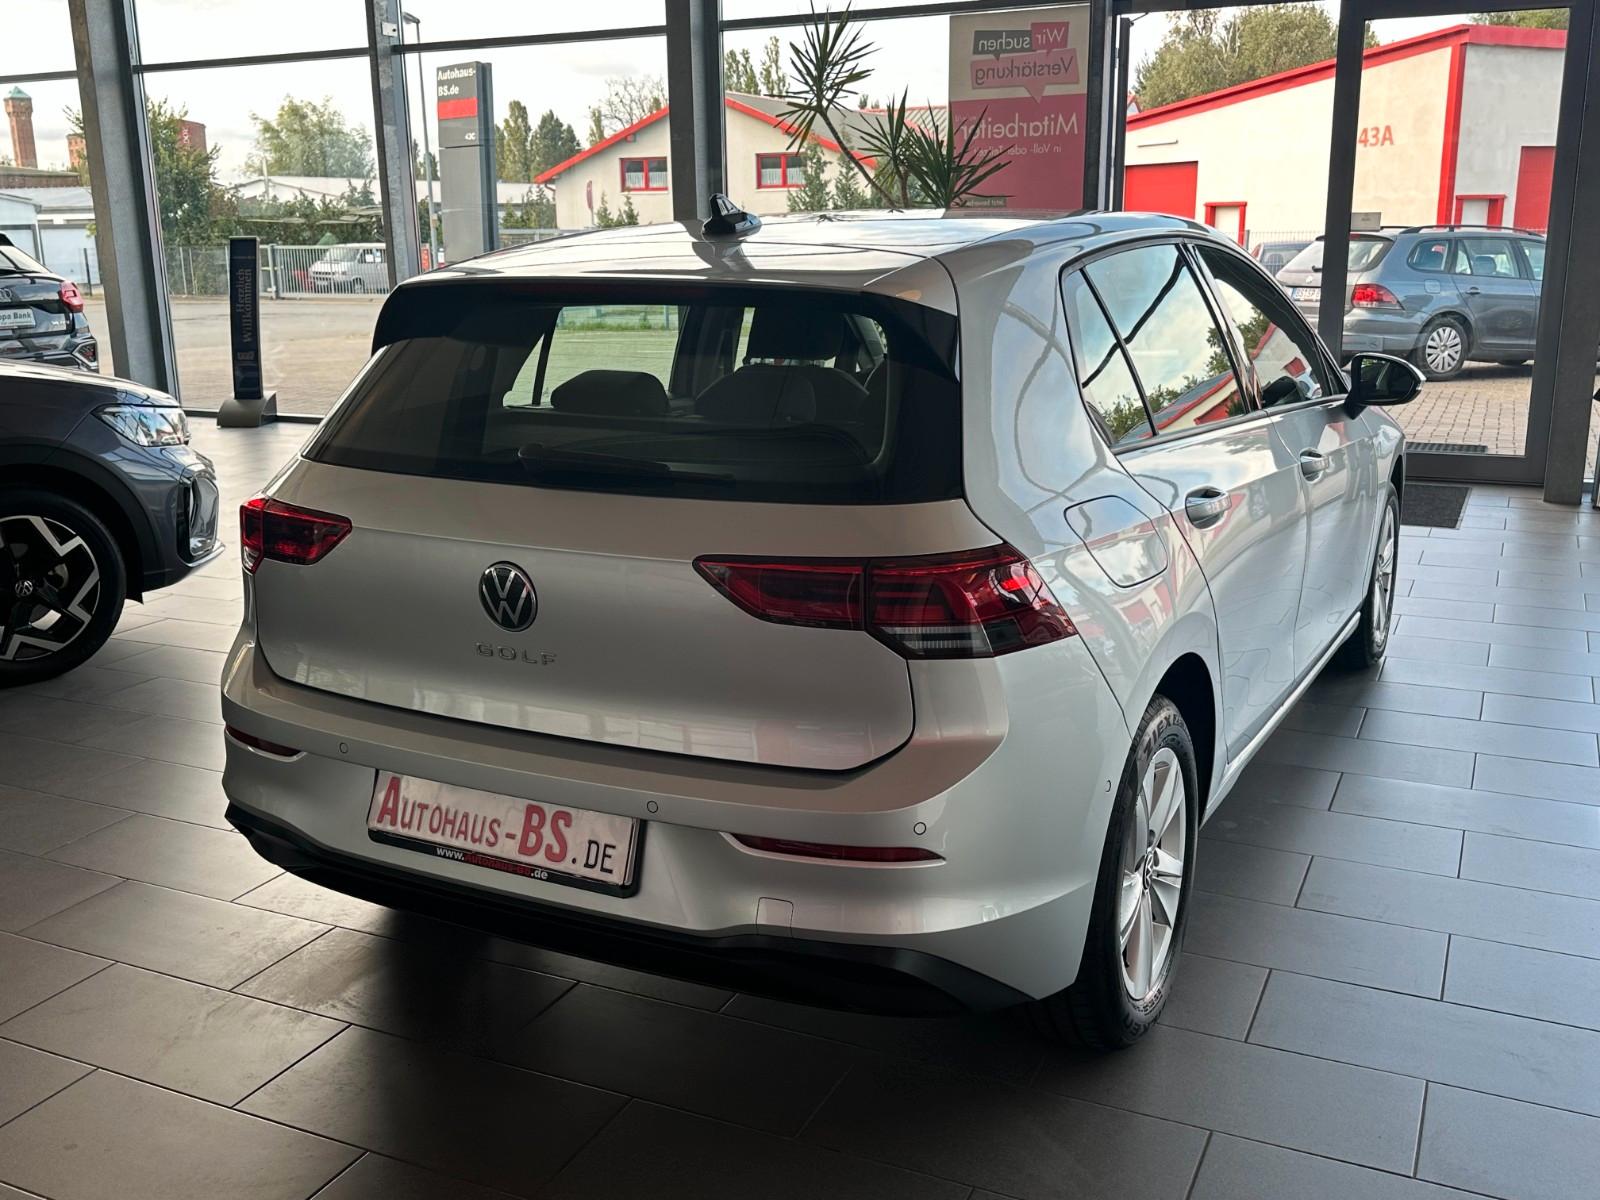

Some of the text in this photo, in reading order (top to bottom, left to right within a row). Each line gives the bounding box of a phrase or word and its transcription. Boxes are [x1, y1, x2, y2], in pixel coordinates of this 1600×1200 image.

[438, 67, 476, 81] Autohaus-
[438, 84, 460, 96] BS.de
[1358, 125, 1394, 147] 43A
[236, 268, 246, 313] Herzlich
[242, 268, 253, 343] Willkommen
[475, 641, 557, 666] GOLF
